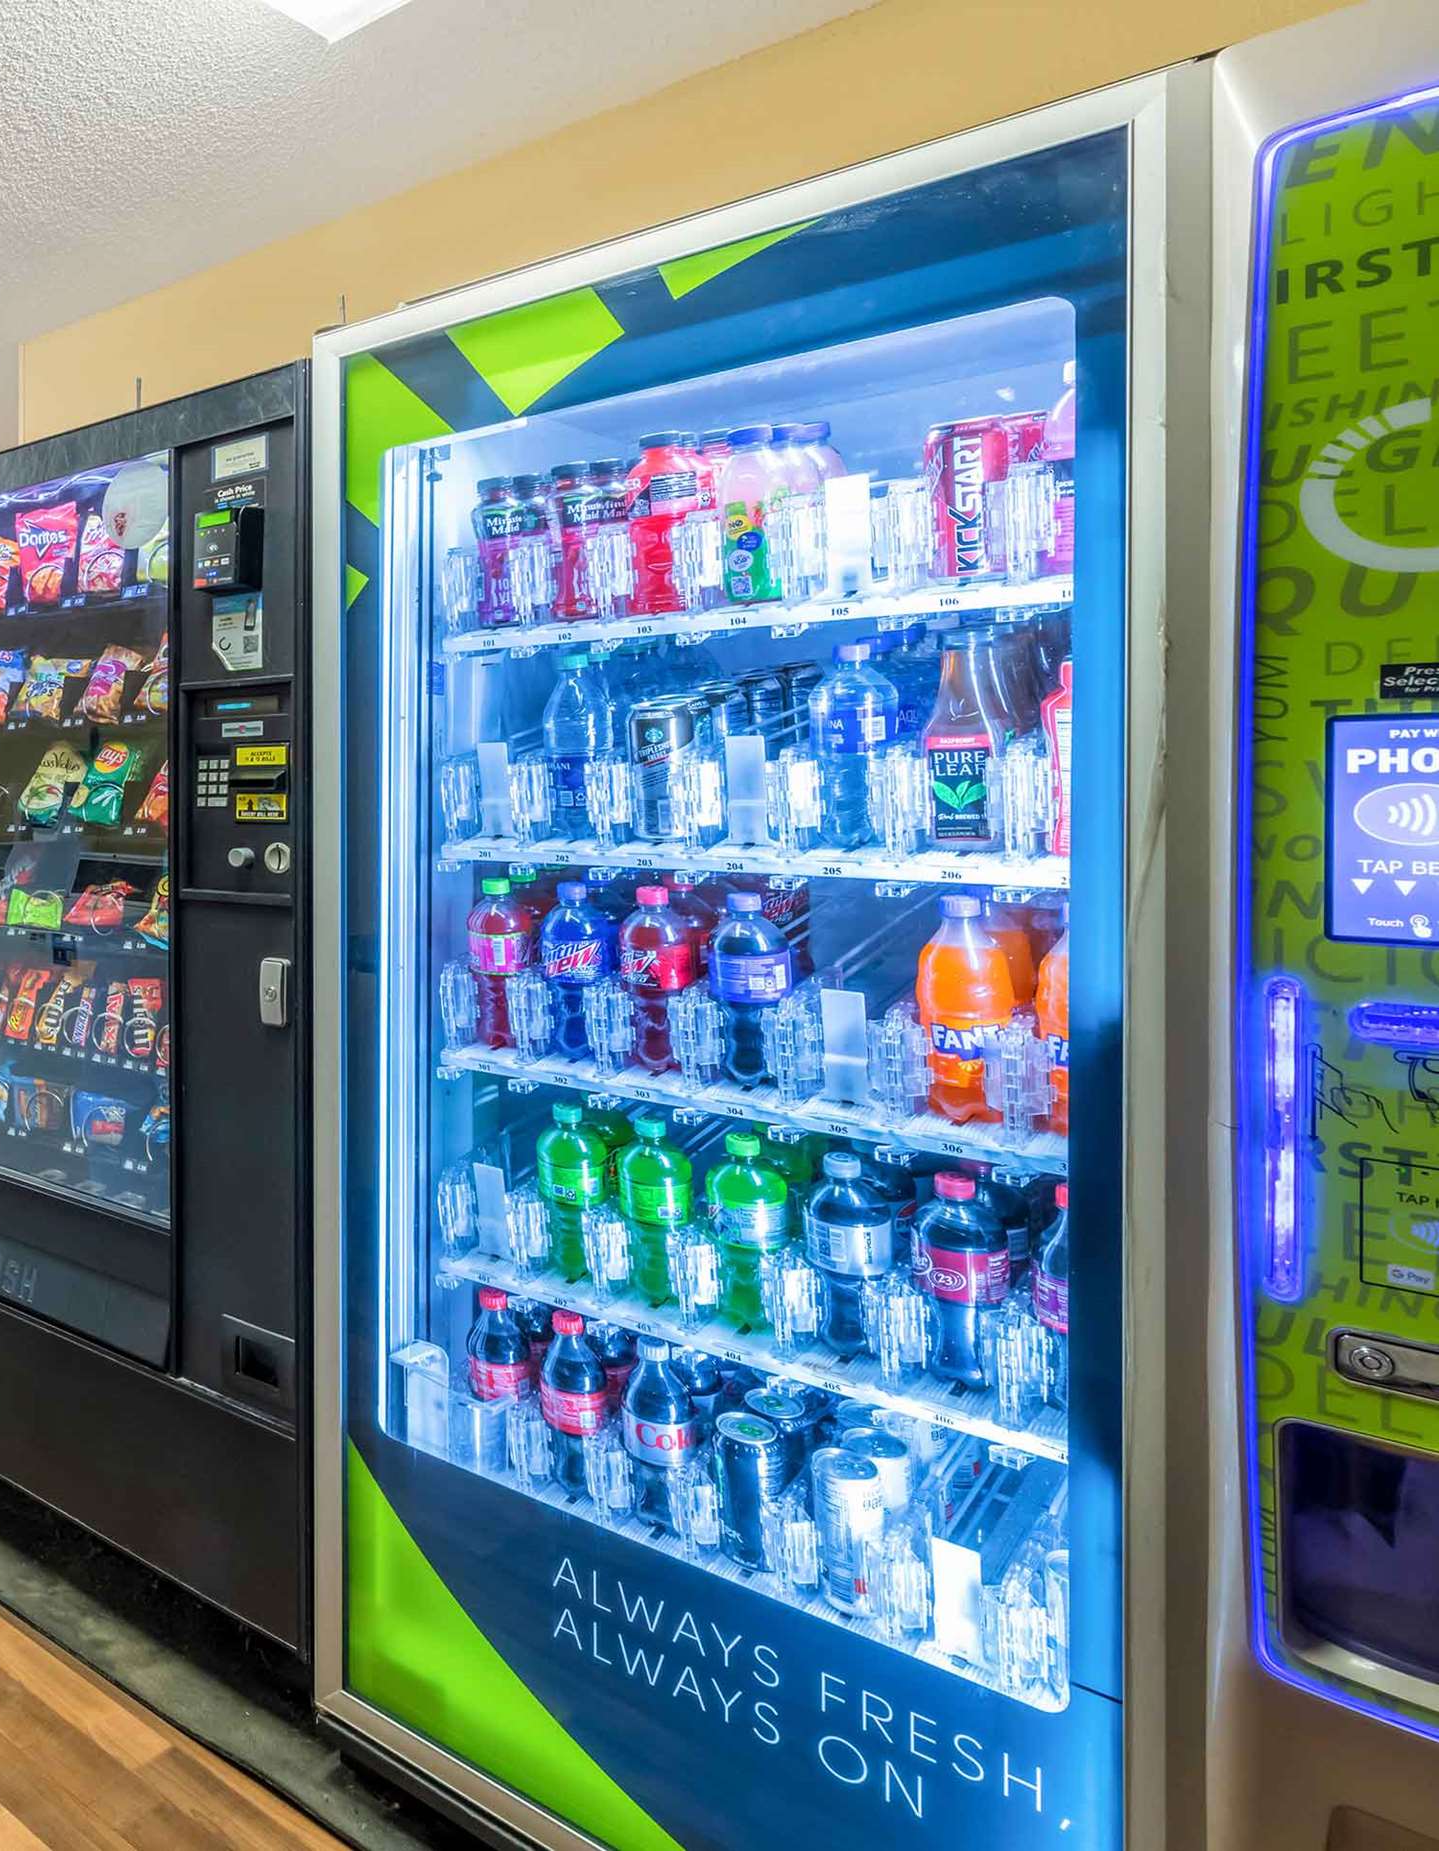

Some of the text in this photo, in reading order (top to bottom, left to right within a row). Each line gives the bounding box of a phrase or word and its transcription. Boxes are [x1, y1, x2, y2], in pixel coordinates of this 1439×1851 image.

[831, 607, 849, 616] 105
[729, 616, 747, 626] 104
[636, 625, 653, 635] 103
[557, 632, 572, 641] 102
[482, 638, 496, 647] 101
[1389, 729, 1421, 739] PAY
[934, 750, 986, 764] PURE
[479, 850, 492, 859] 201
[555, 854, 570, 863] 202
[637, 858, 654, 868] 203
[726, 862, 744, 872] 204
[1357, 859, 1403, 875] TAP
[823, 867, 842, 876] 205
[941, 870, 962, 880] 206
[1367, 917, 1404, 929] Touch
[553, 1076, 568, 1085] 302
[634, 1089, 651, 1099] 303
[726, 1106, 744, 1117] 304
[828, 1124, 848, 1135] 305
[942, 1142, 963, 1154] 306
[552, 1557, 781, 1688] ALWAYS
[552, 1608, 924, 1819] ALWAYS ON
